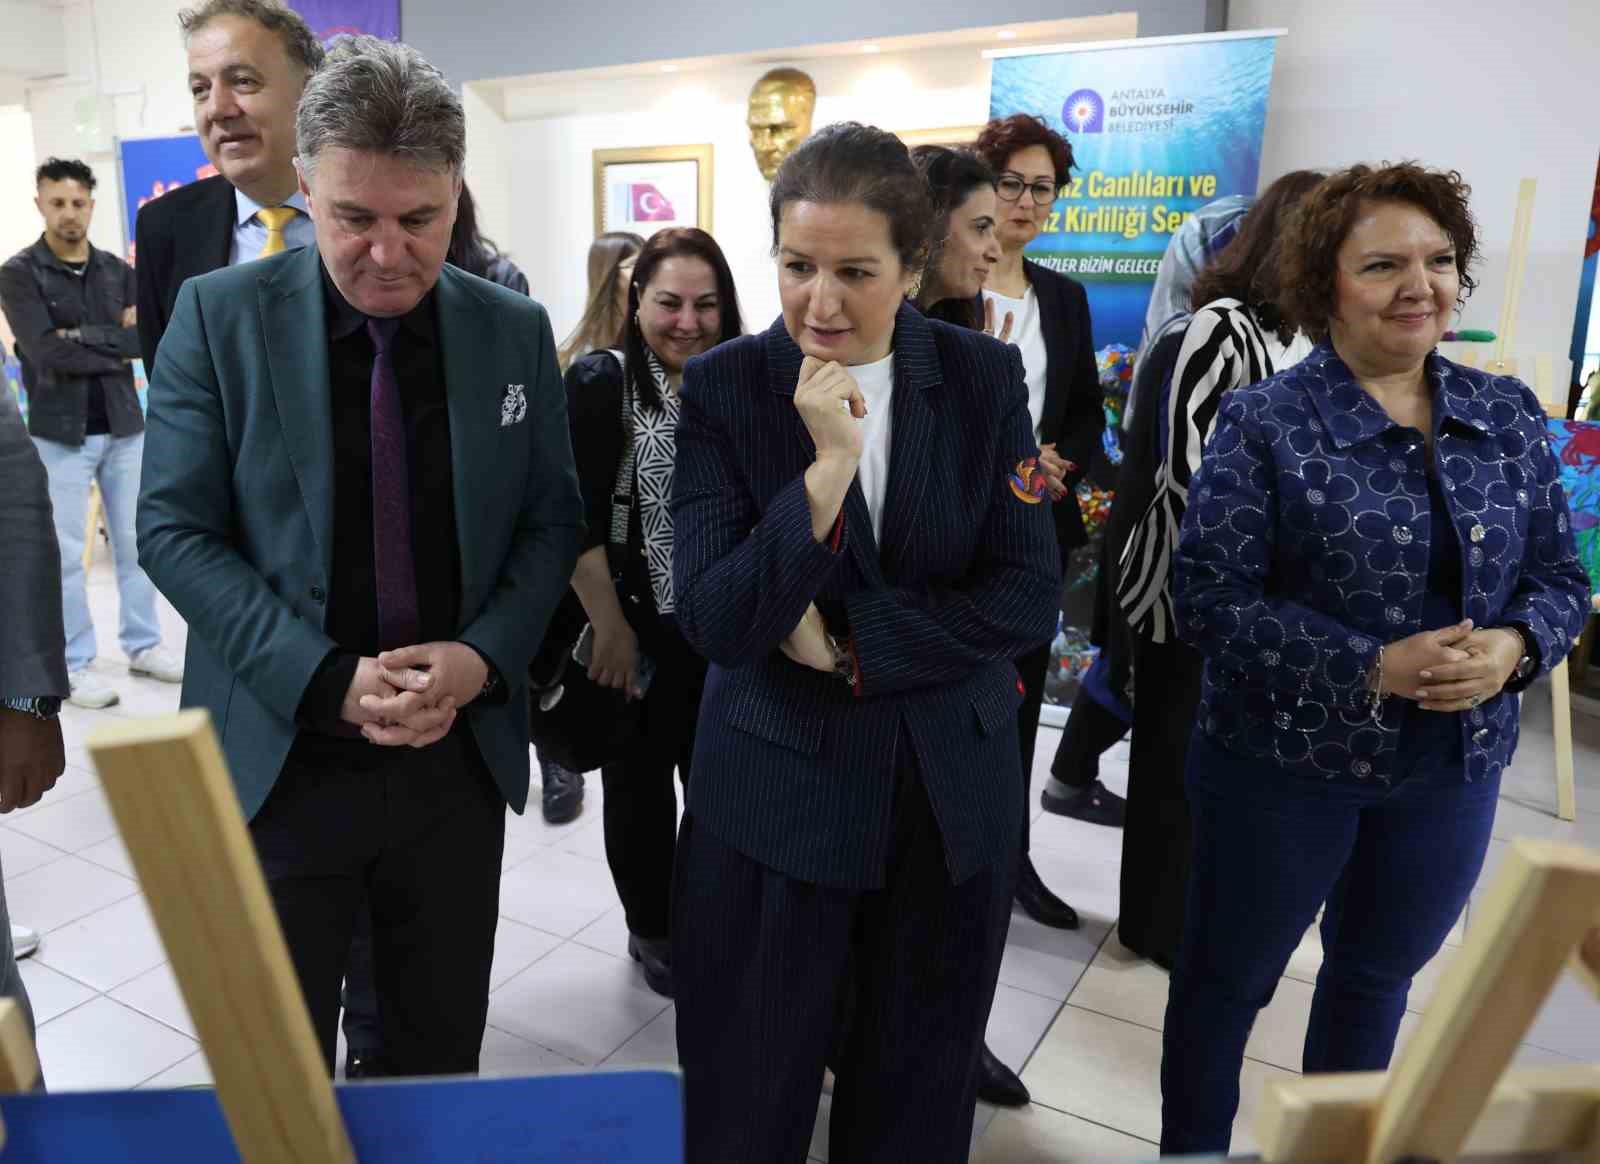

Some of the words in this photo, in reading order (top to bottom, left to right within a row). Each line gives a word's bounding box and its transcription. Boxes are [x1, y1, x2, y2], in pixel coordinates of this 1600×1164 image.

[1112, 88, 1165, 100] ANTALYA
[1109, 99, 1193, 118] BÜYÜKŞEHİR
[1088, 170, 1184, 199] Canlıları
[1189, 174, 1217, 198] ve
[1065, 203, 1147, 239] Kirliliği
[1078, 255, 1113, 273] BİZİM
